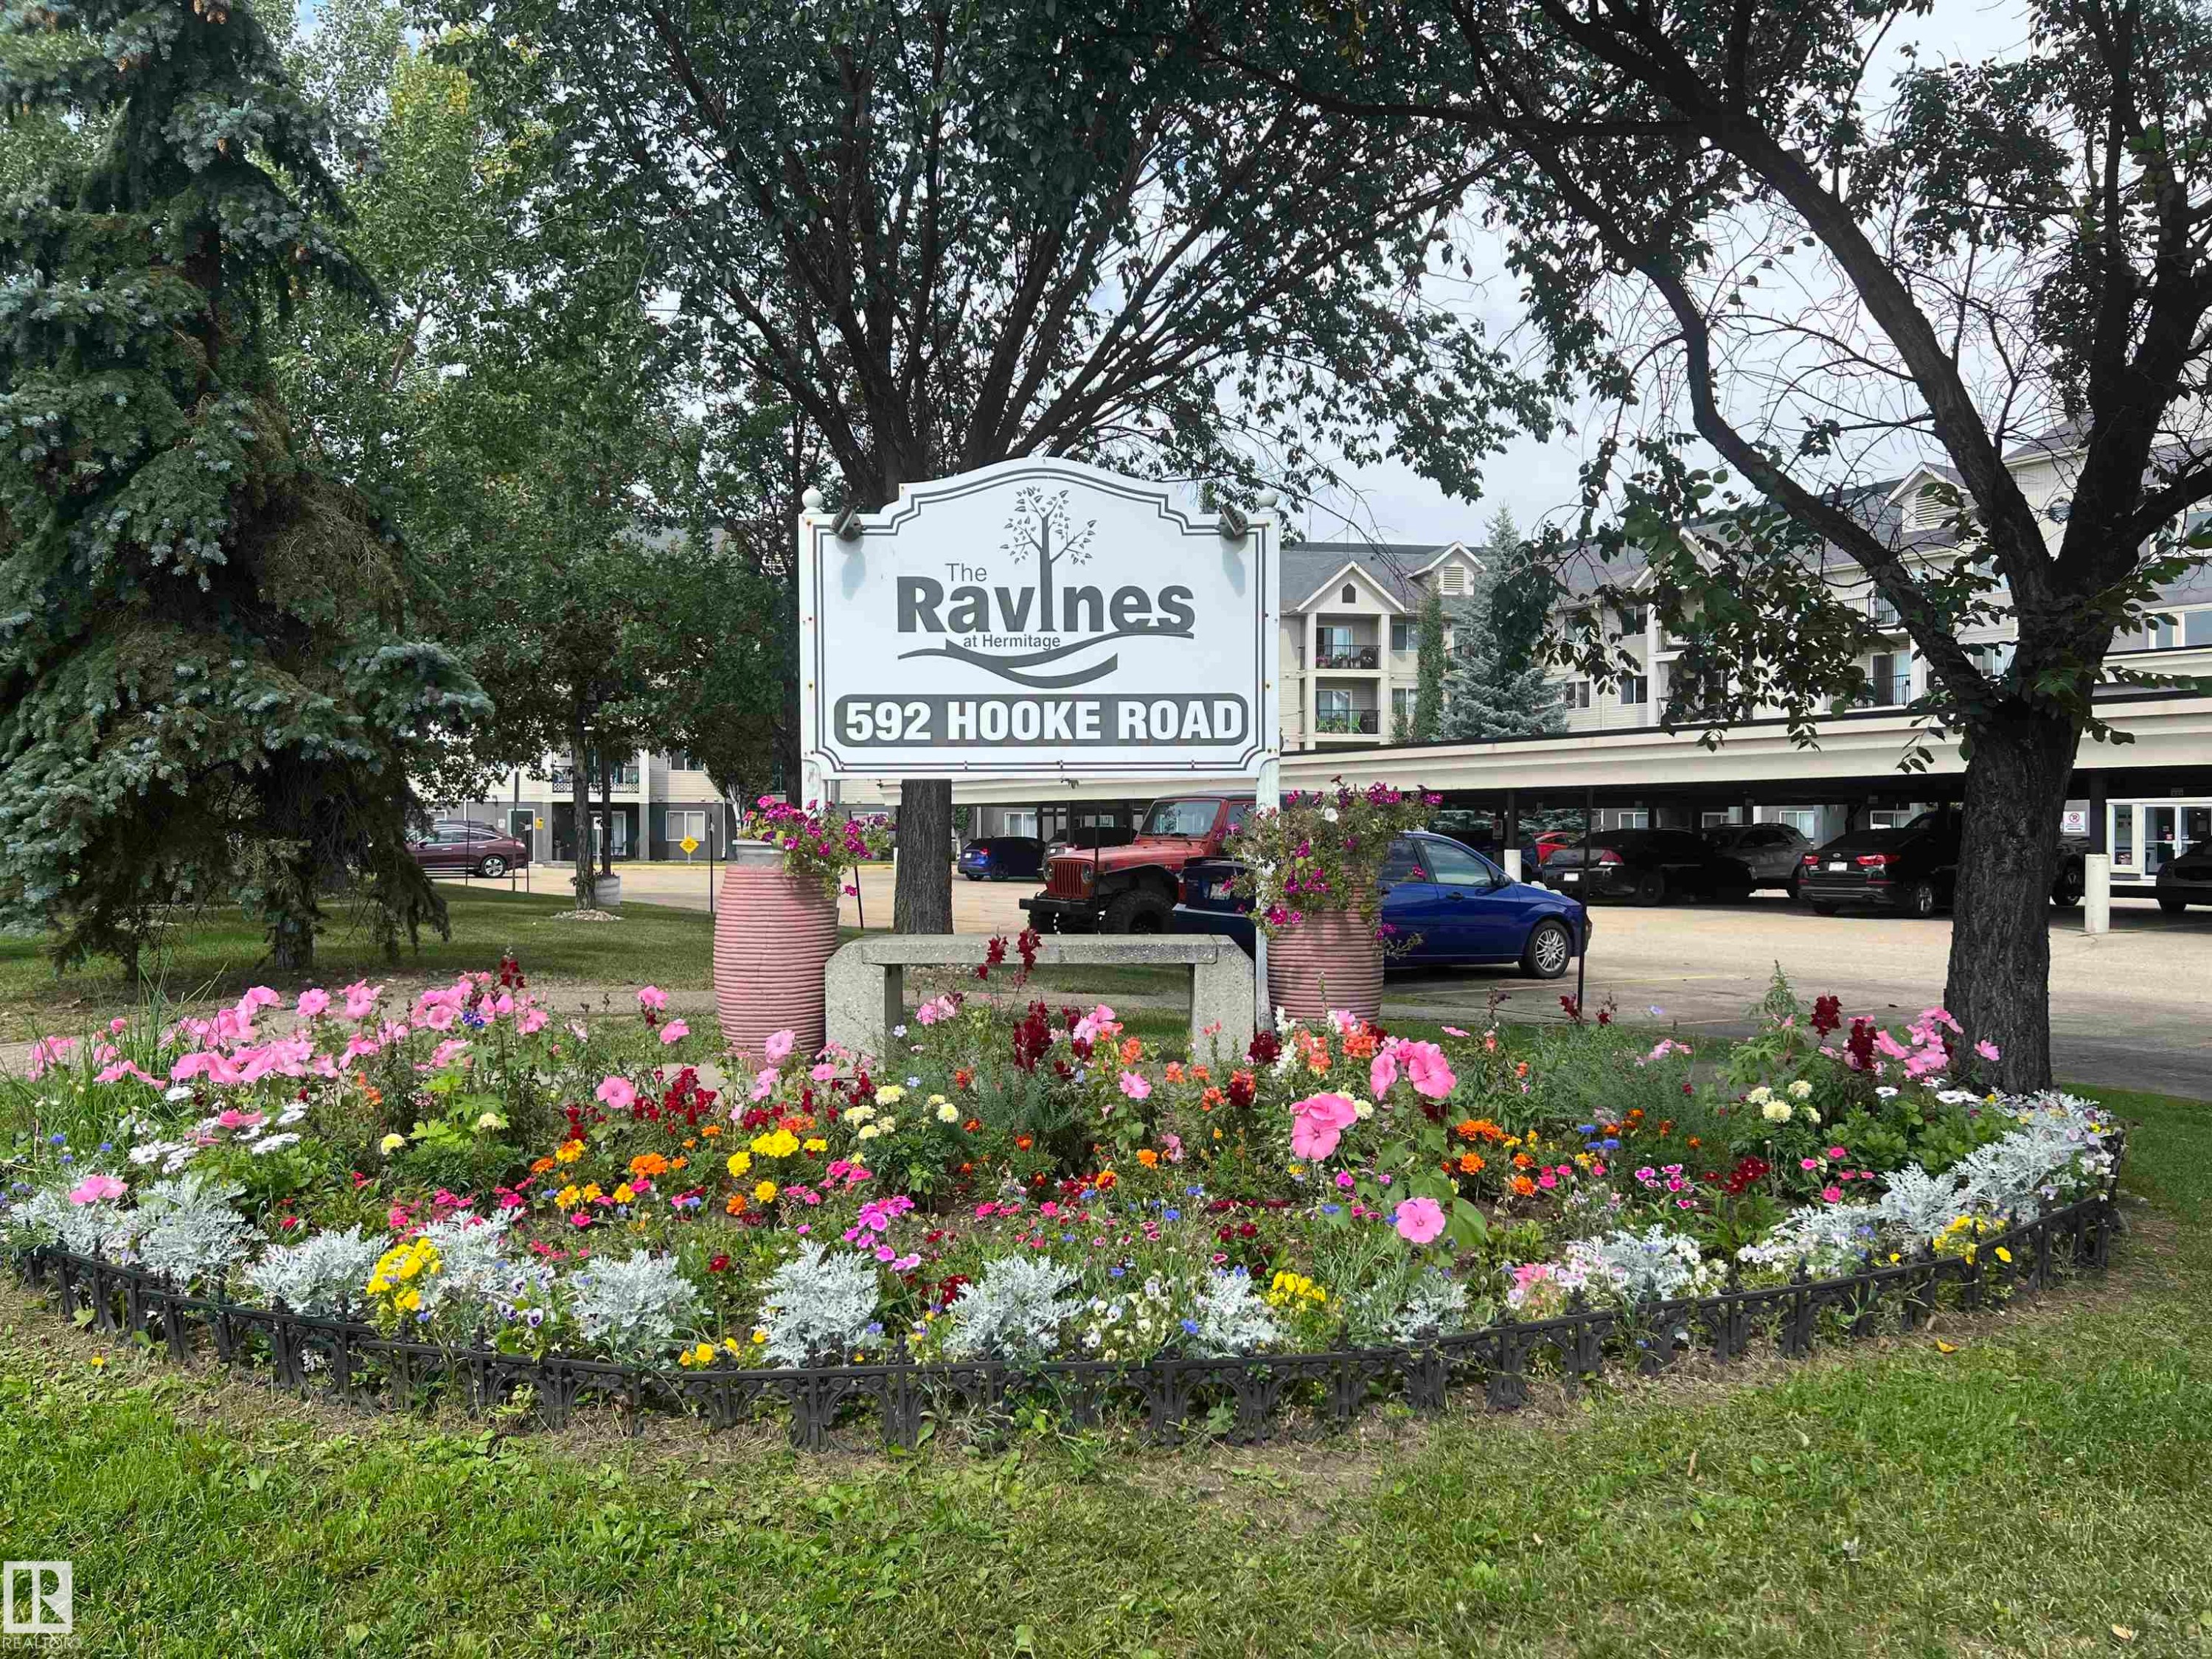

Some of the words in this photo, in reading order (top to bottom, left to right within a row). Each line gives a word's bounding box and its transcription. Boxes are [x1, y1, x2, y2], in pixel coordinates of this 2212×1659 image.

[945, 563, 988, 582] The
[897, 576, 1195, 633] Ravines
[963, 634, 978, 647] at
[982, 633, 1061, 650] Hermitage
[846, 701, 931, 740] 592
[947, 701, 1101, 740] HOOKE
[1118, 700, 1243, 740] ROAD
